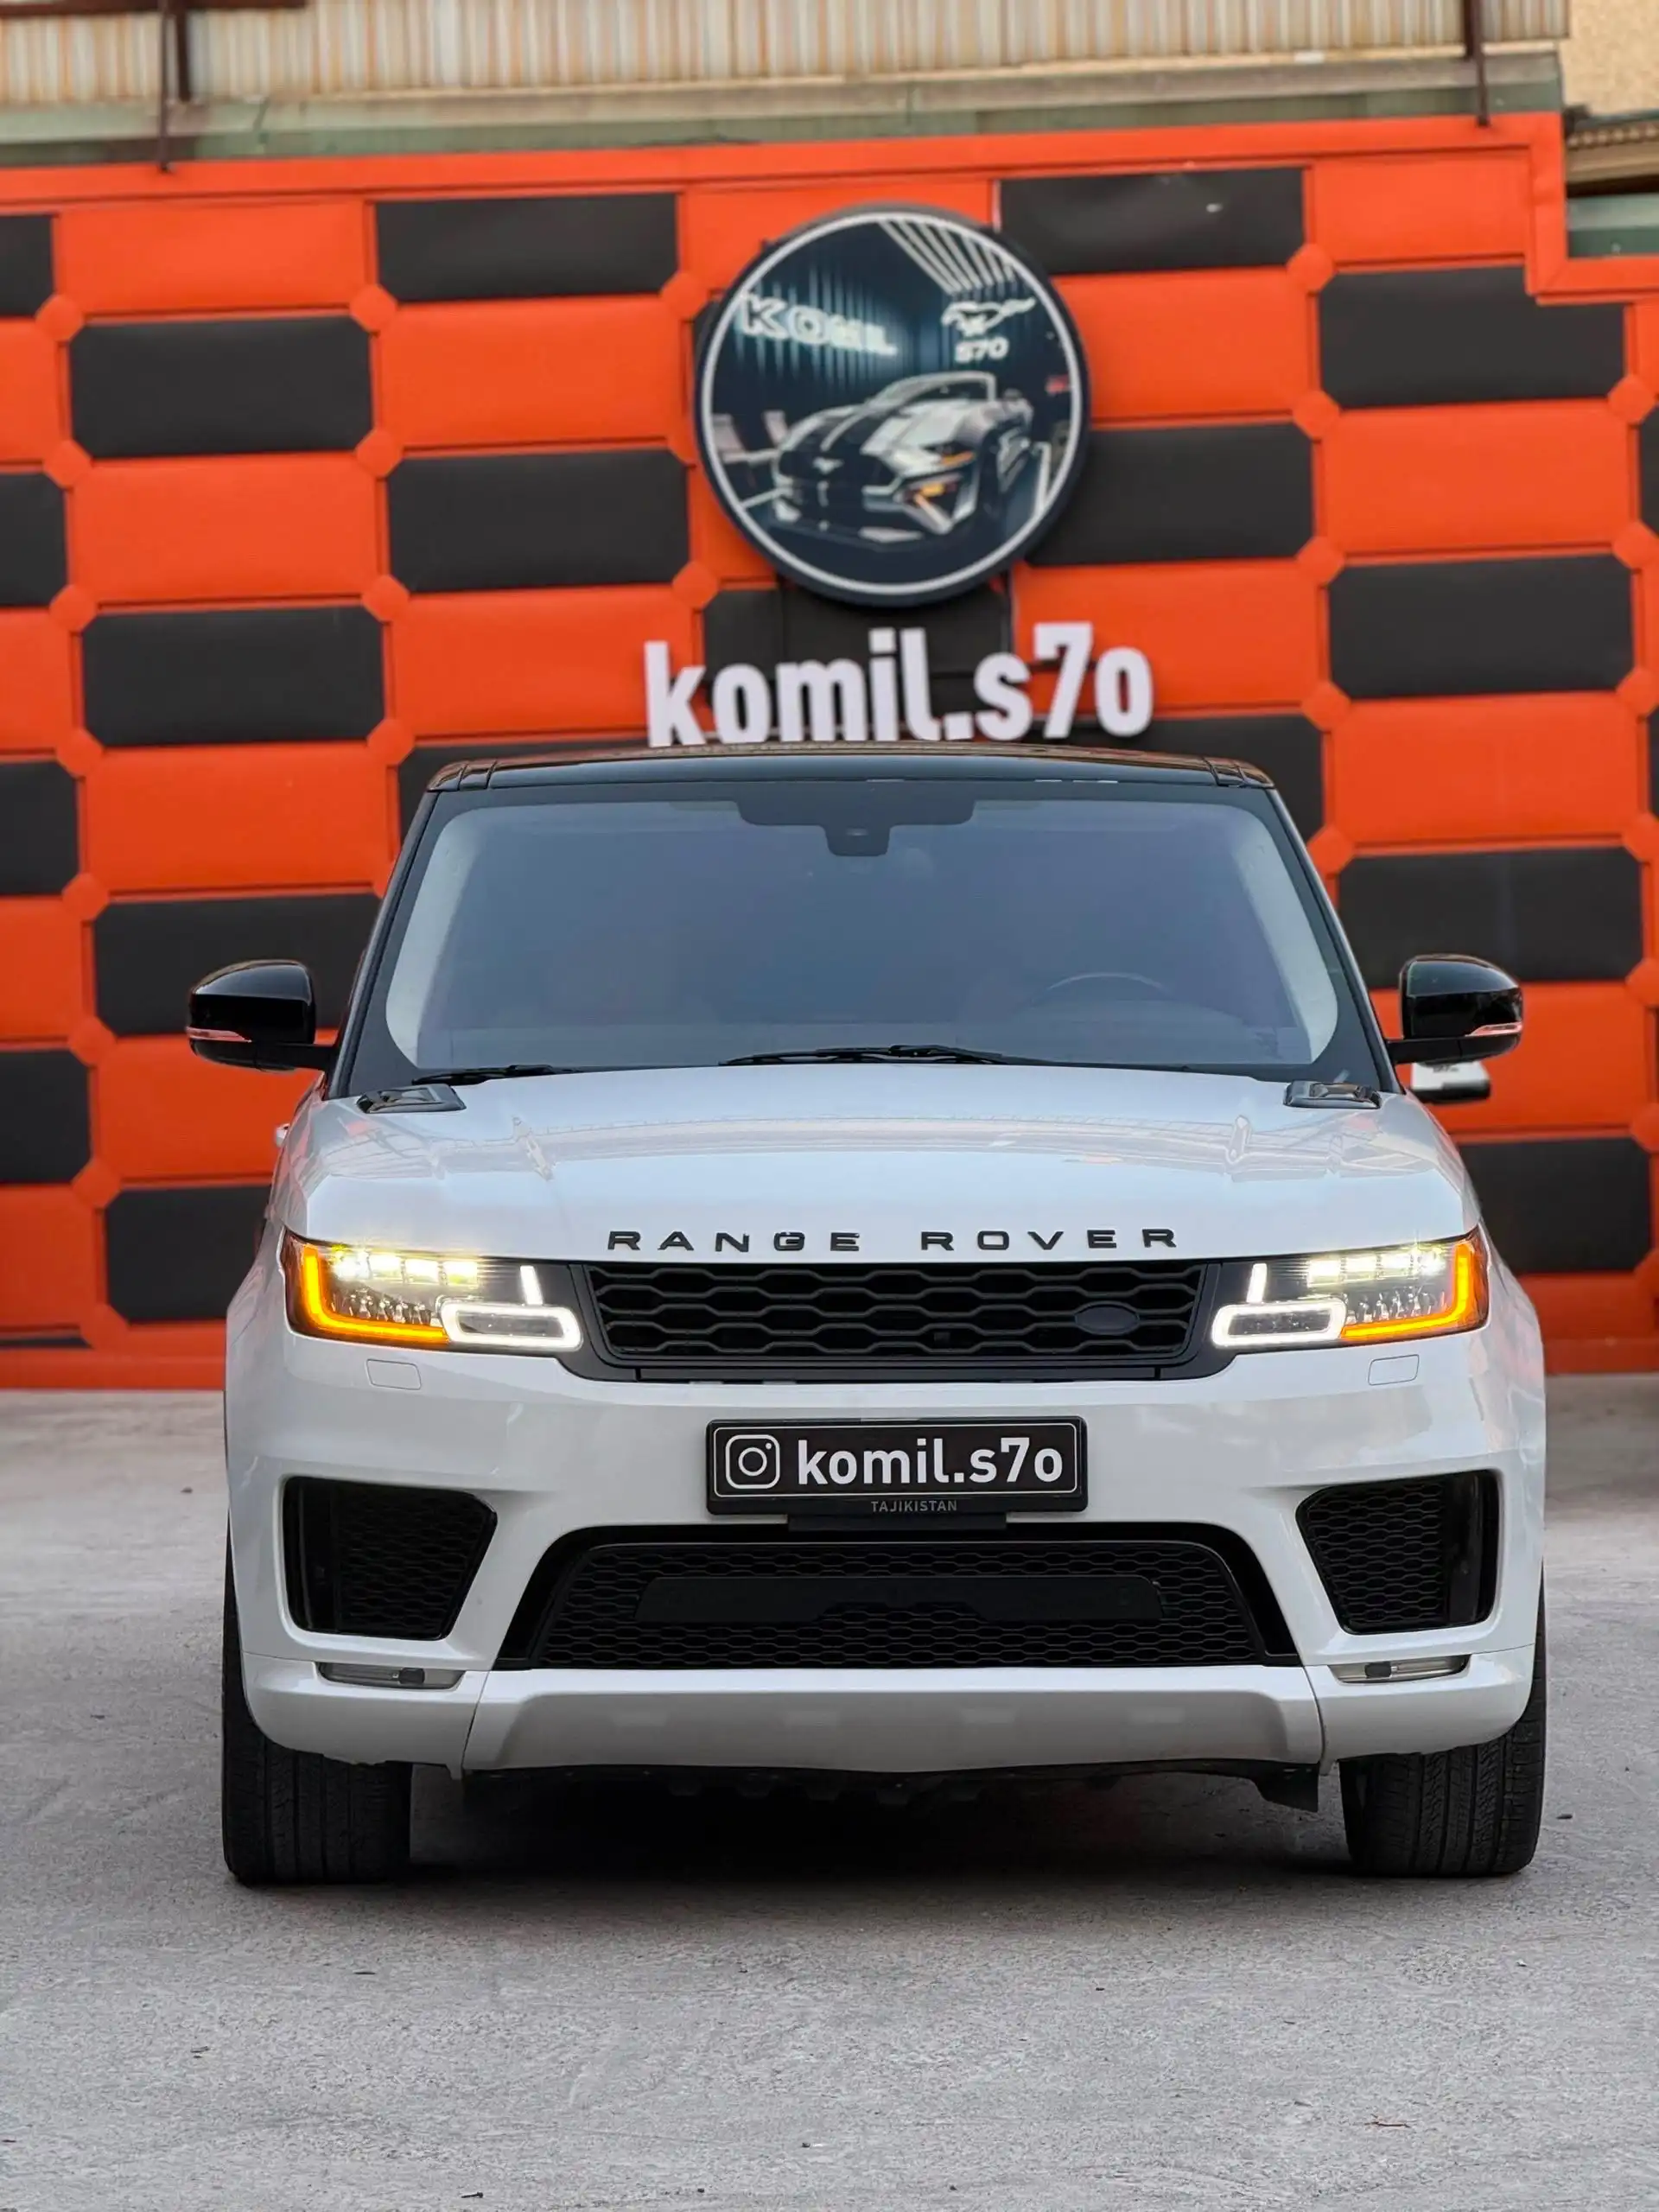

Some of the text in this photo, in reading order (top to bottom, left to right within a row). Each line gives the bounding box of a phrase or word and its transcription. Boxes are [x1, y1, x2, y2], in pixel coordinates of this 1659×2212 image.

[645, 622, 1153, 747] komil.s7o
[607, 1229, 1176, 1252] RANGE ROVER
[798, 1437, 1063, 1484] komil.s7o
[871, 1500, 957, 1513] TAJIKISTAN
